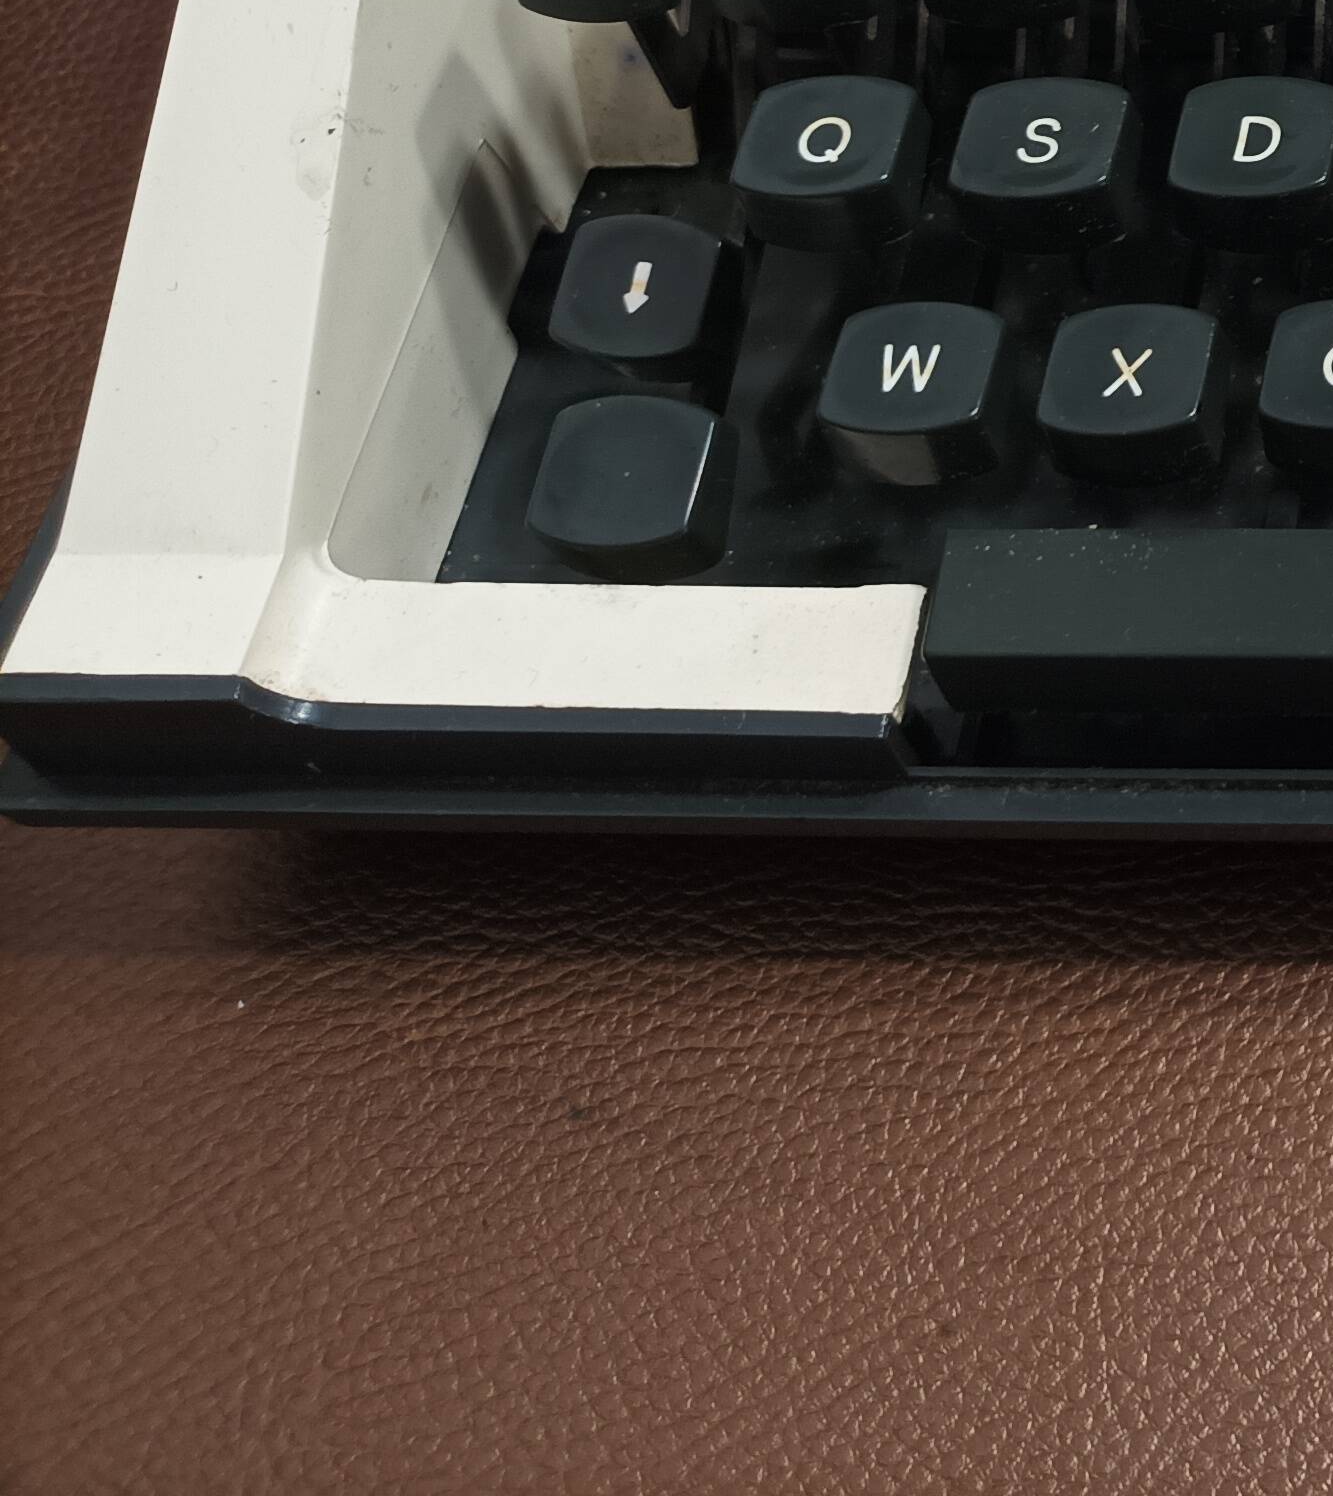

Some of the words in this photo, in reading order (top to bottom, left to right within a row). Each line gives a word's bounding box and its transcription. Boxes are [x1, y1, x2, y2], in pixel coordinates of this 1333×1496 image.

[797, 115, 853, 164] Q
[1015, 116, 1063, 165] S
[1232, 114, 1283, 164] D
[881, 342, 942, 394] W
[1102, 347, 1154, 398] X
